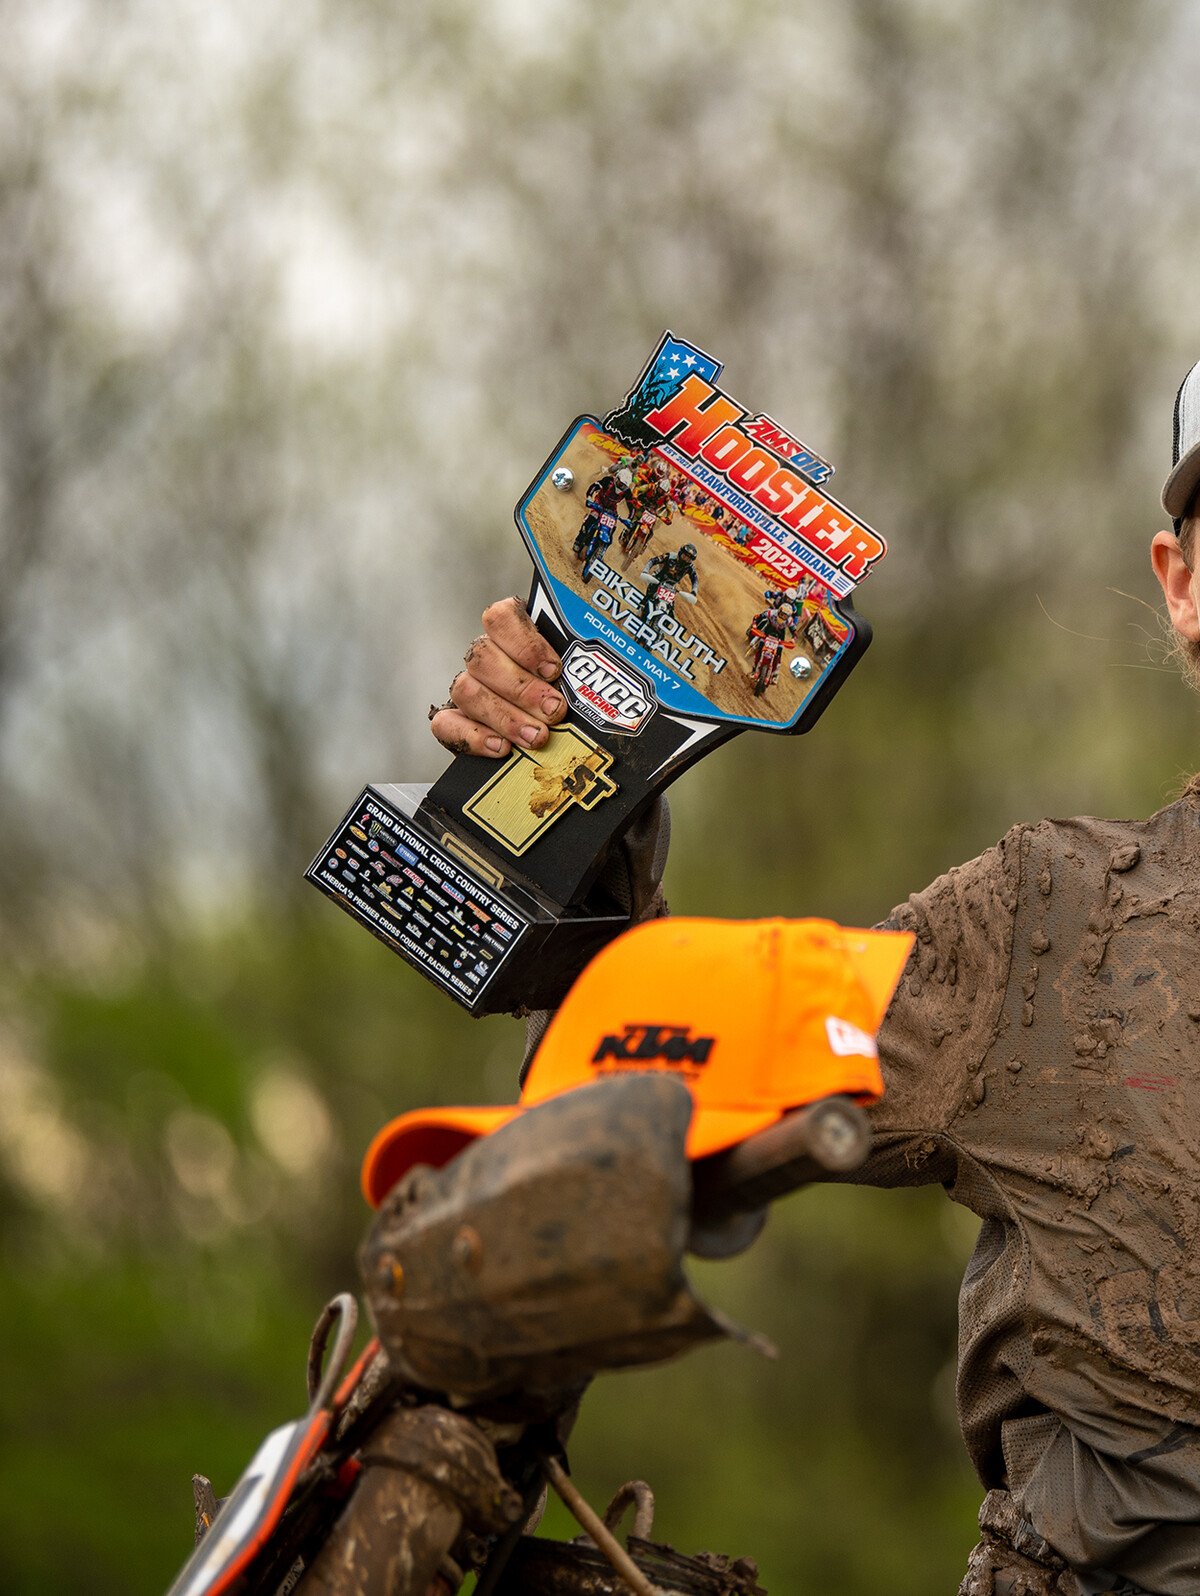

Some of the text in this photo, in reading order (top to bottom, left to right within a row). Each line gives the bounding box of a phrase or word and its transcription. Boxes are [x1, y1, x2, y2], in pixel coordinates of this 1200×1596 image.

[644, 373, 884, 578] HOOSIER
[742, 418, 833, 482] AMSOIL
[600, 513, 616, 529] 212
[663, 446, 677, 457] EST
[676, 456, 692, 470] 2021
[691, 464, 788, 545] CRAWFORDSVILLE,
[787, 536, 837, 582] INDIANA
[751, 538, 805, 579] 2023
[588, 559, 727, 674] BIKE YOUTH
[658, 587, 675, 602] 342
[583, 612, 681, 690] ROUND 6 MAY 7
[591, 588, 696, 680] OVERALL
[567, 655, 647, 719] GNCC
[577, 684, 620, 719] RACING
[367, 803, 393, 827] GRAND
[392, 824, 428, 858] NATIONAL
[430, 854, 456, 878] CROSS
[456, 875, 492, 906] COUNTRY
[490, 904, 519, 929] SERIES
[403, 867, 424, 885] KENDA
[321, 871, 354, 898] AMERICA'S
[353, 896, 379, 920] PREMIER
[379, 917, 400, 936] CROSS
[400, 934, 428, 958] COUNTRY
[427, 956, 451, 978] RACING
[450, 975, 472, 995] SERIES
[592, 1025, 715, 1064] KTM
